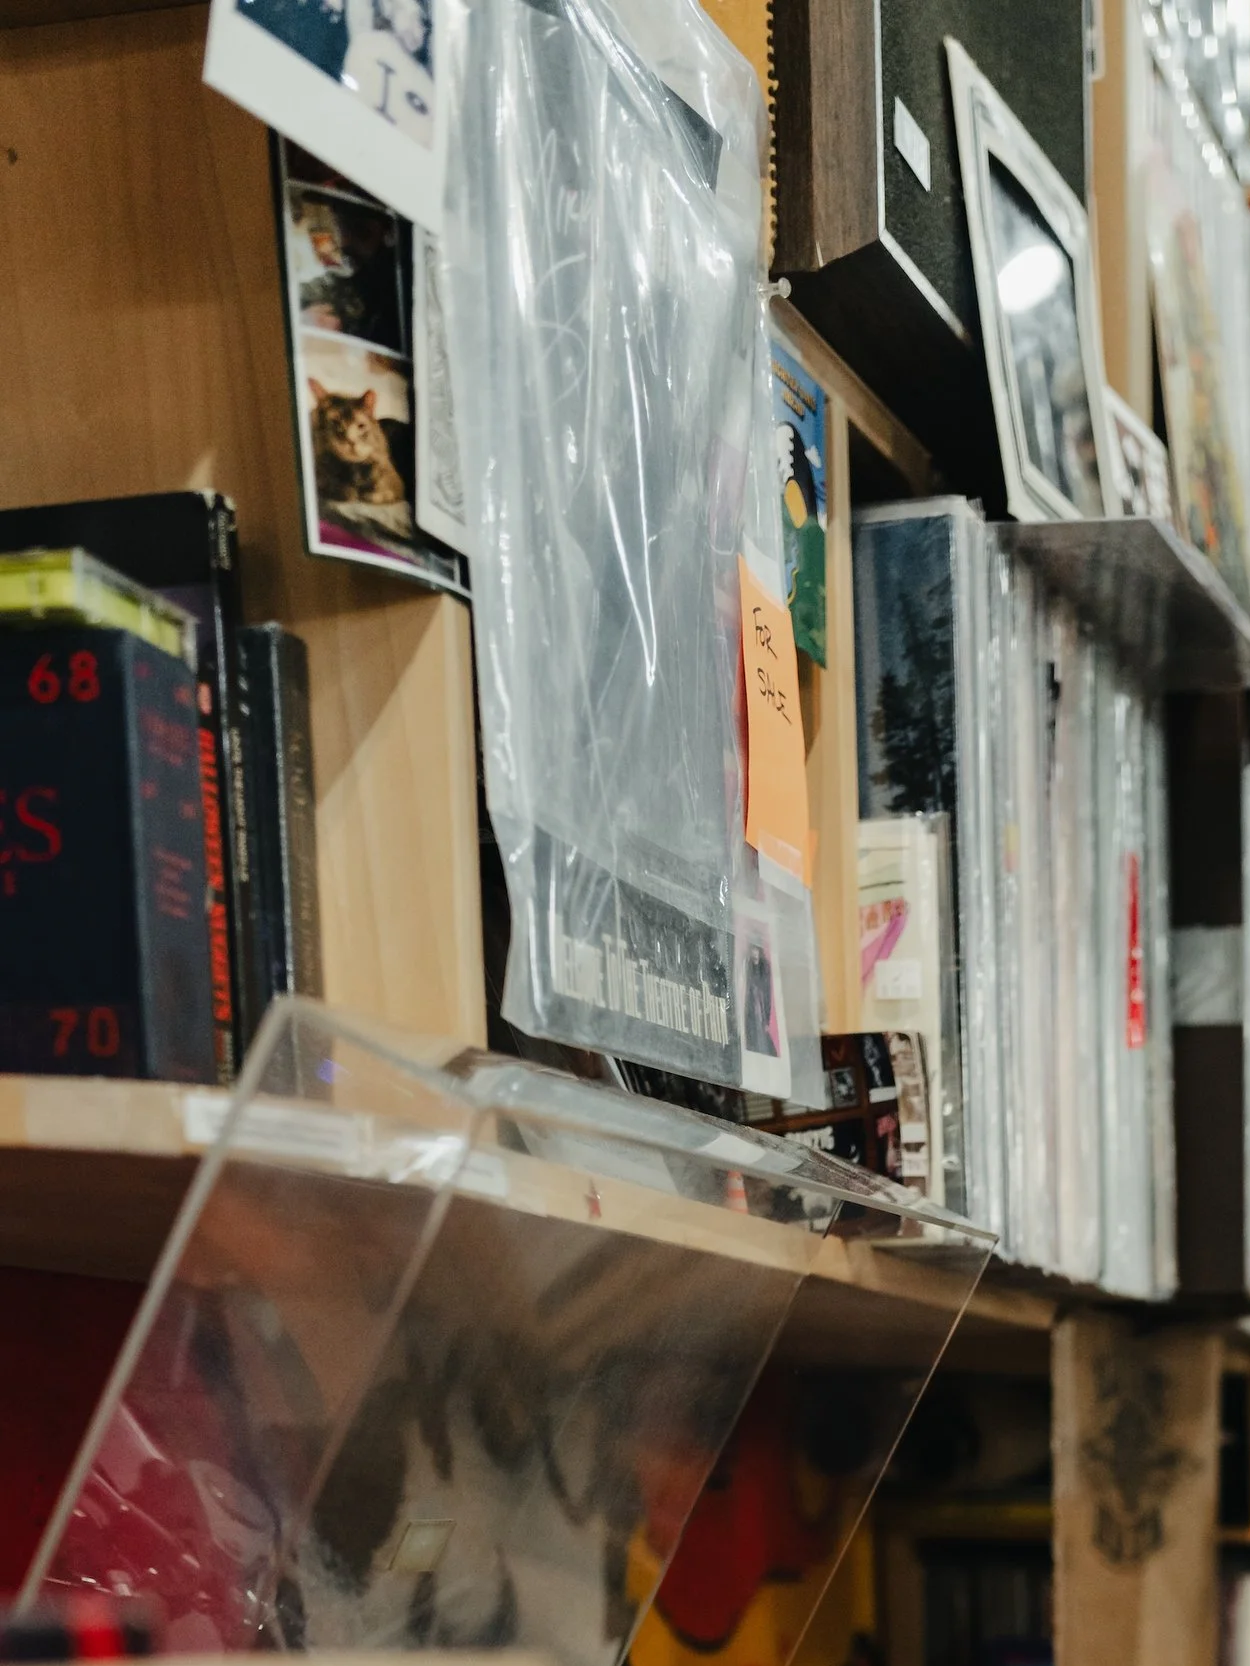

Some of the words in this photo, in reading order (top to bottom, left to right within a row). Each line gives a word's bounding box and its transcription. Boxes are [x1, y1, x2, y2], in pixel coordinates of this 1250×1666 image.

[752, 605, 779, 660] FOR
[27, 649, 101, 704] 68
[756, 666, 793, 726] SALE
[49, 1005, 121, 1058] 70
